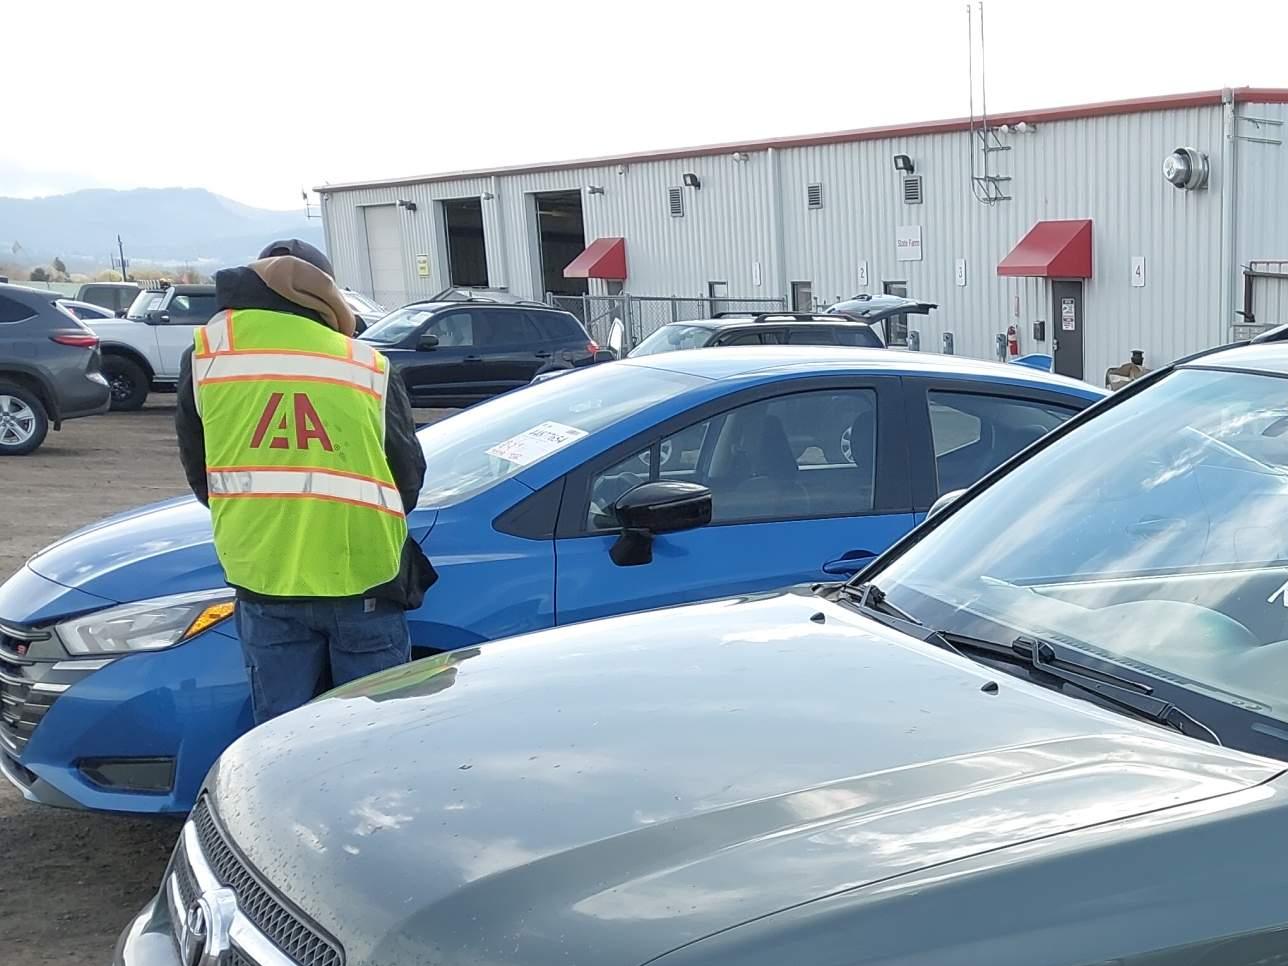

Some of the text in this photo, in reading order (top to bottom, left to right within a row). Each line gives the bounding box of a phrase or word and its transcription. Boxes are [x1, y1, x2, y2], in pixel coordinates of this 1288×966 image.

[860, 267, 865, 279] 2
[958, 267, 963, 278] 3
[1135, 265, 1141, 278] 4
